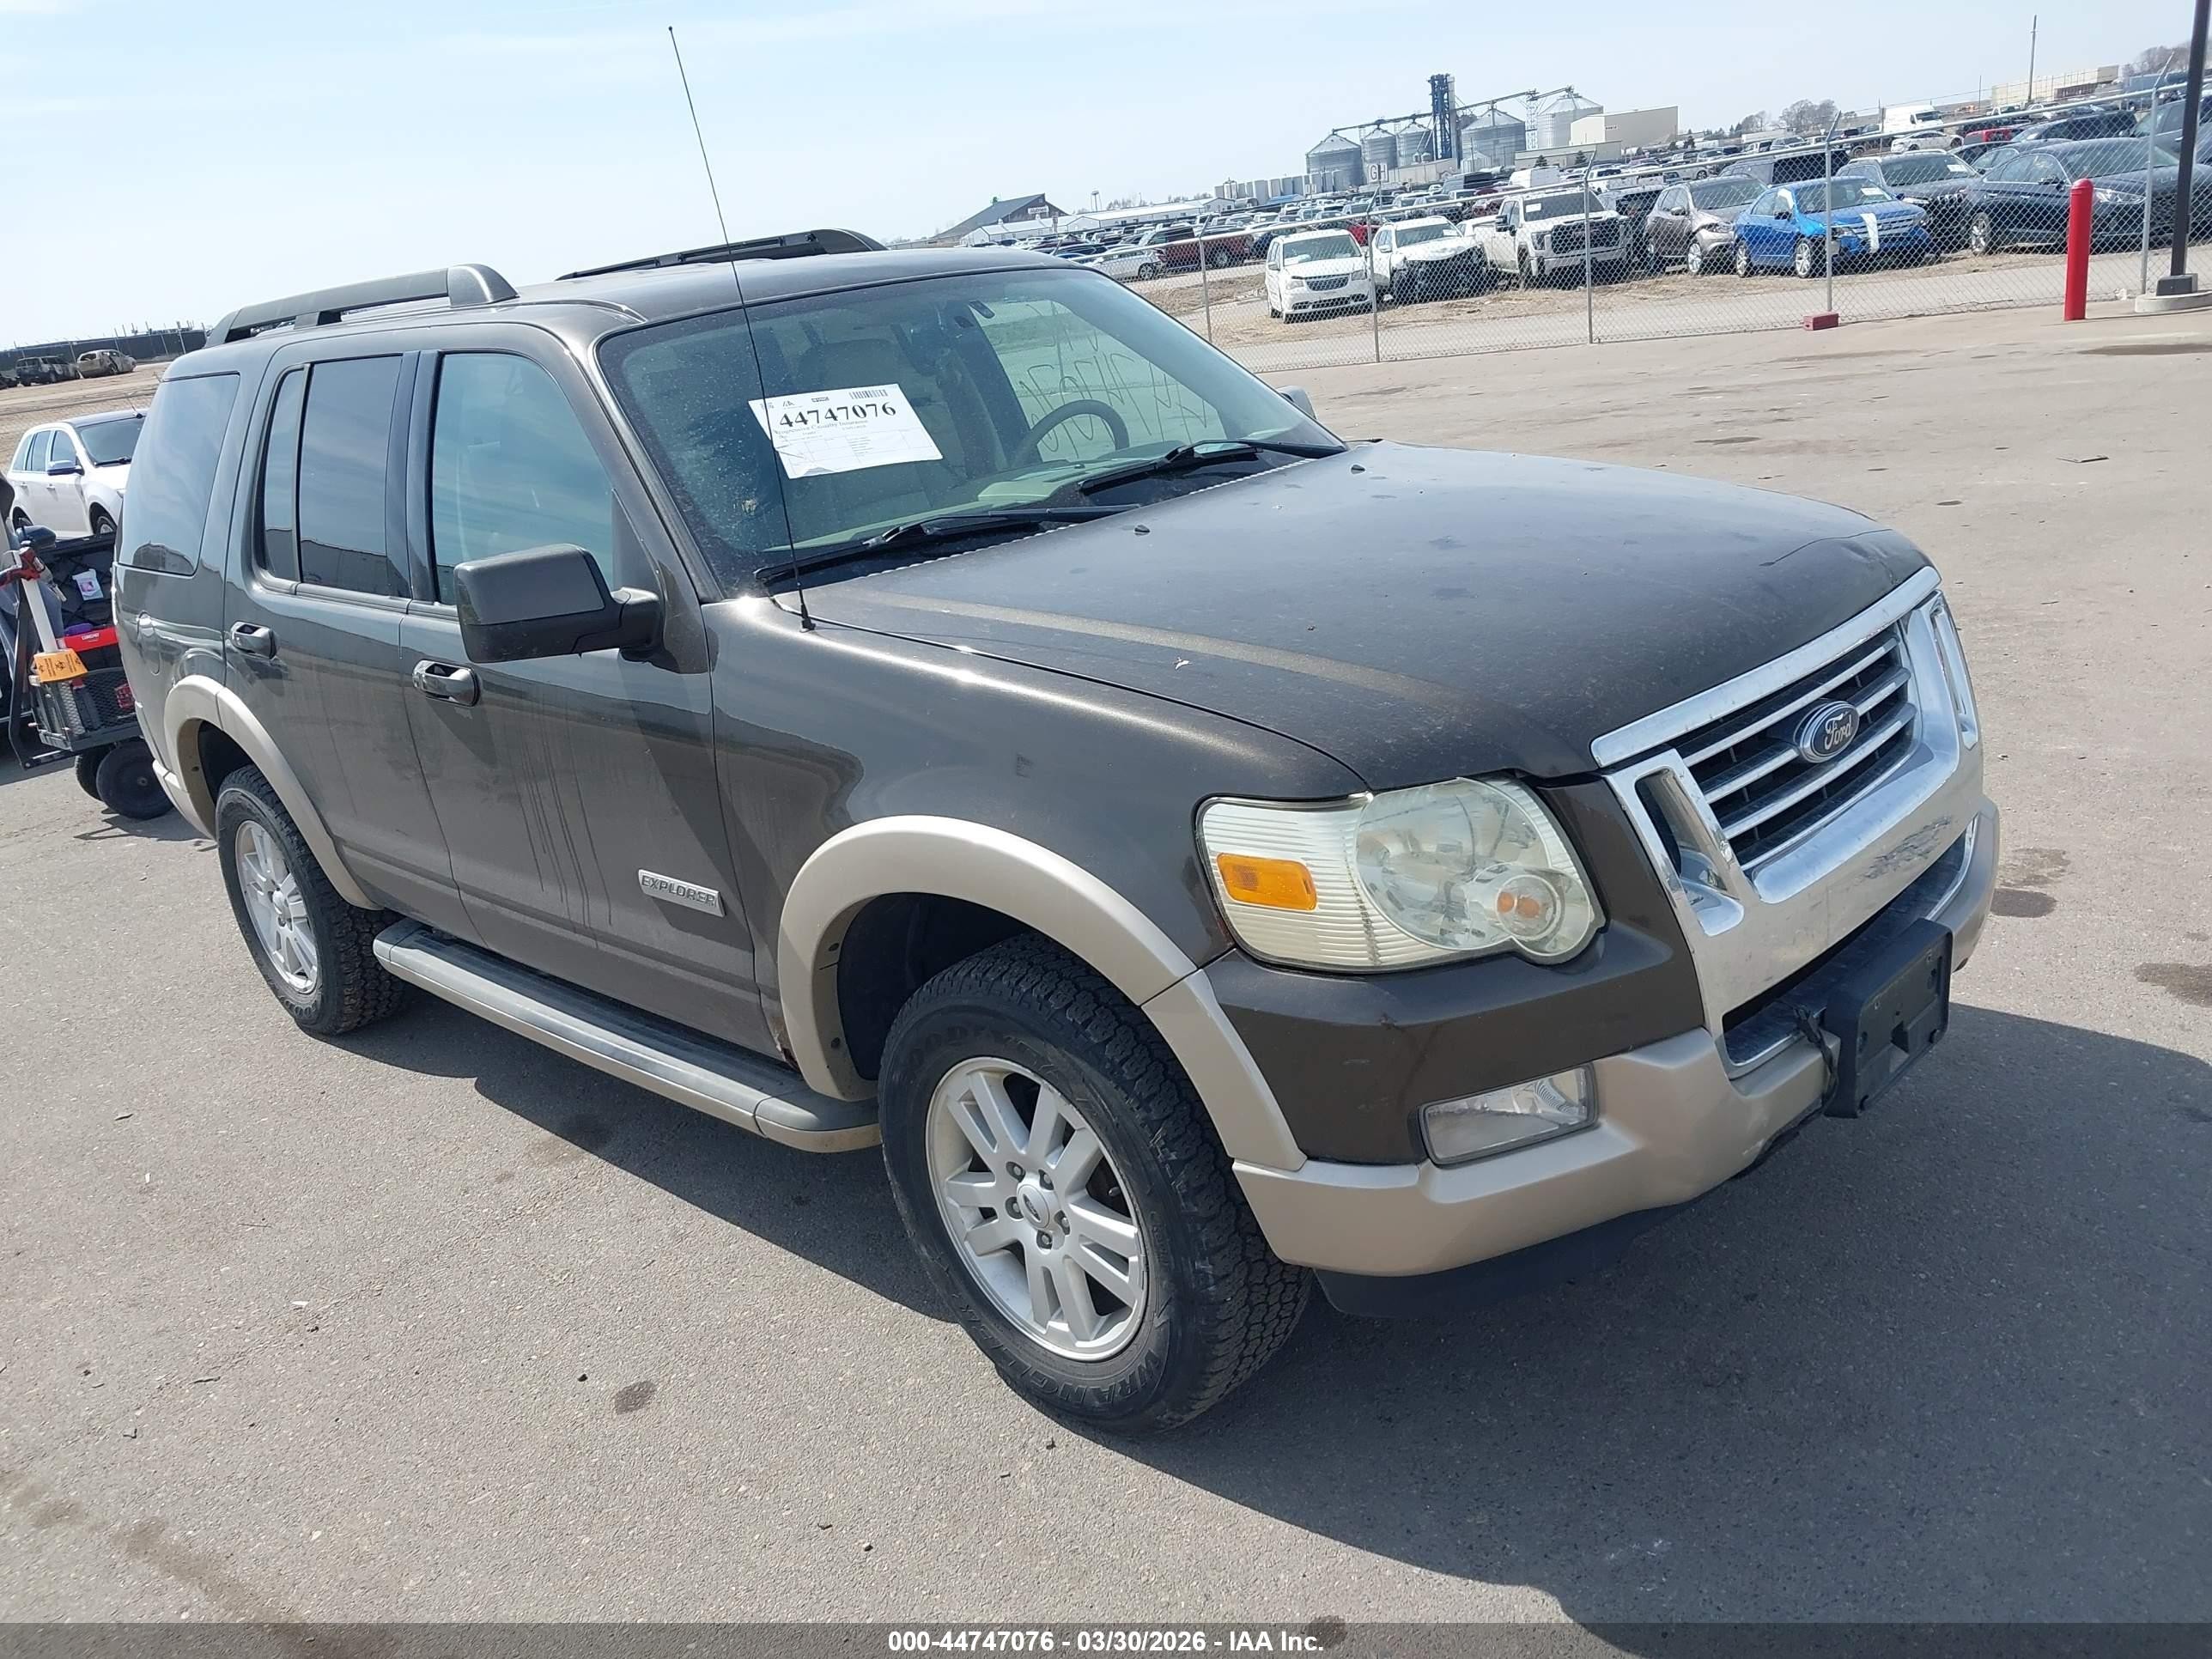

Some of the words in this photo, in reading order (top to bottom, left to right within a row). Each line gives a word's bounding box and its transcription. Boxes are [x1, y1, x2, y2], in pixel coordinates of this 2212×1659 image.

[779, 401, 896, 428] 44747076
[1824, 712, 1852, 750] Ford
[641, 874, 716, 908] EXPLORER
